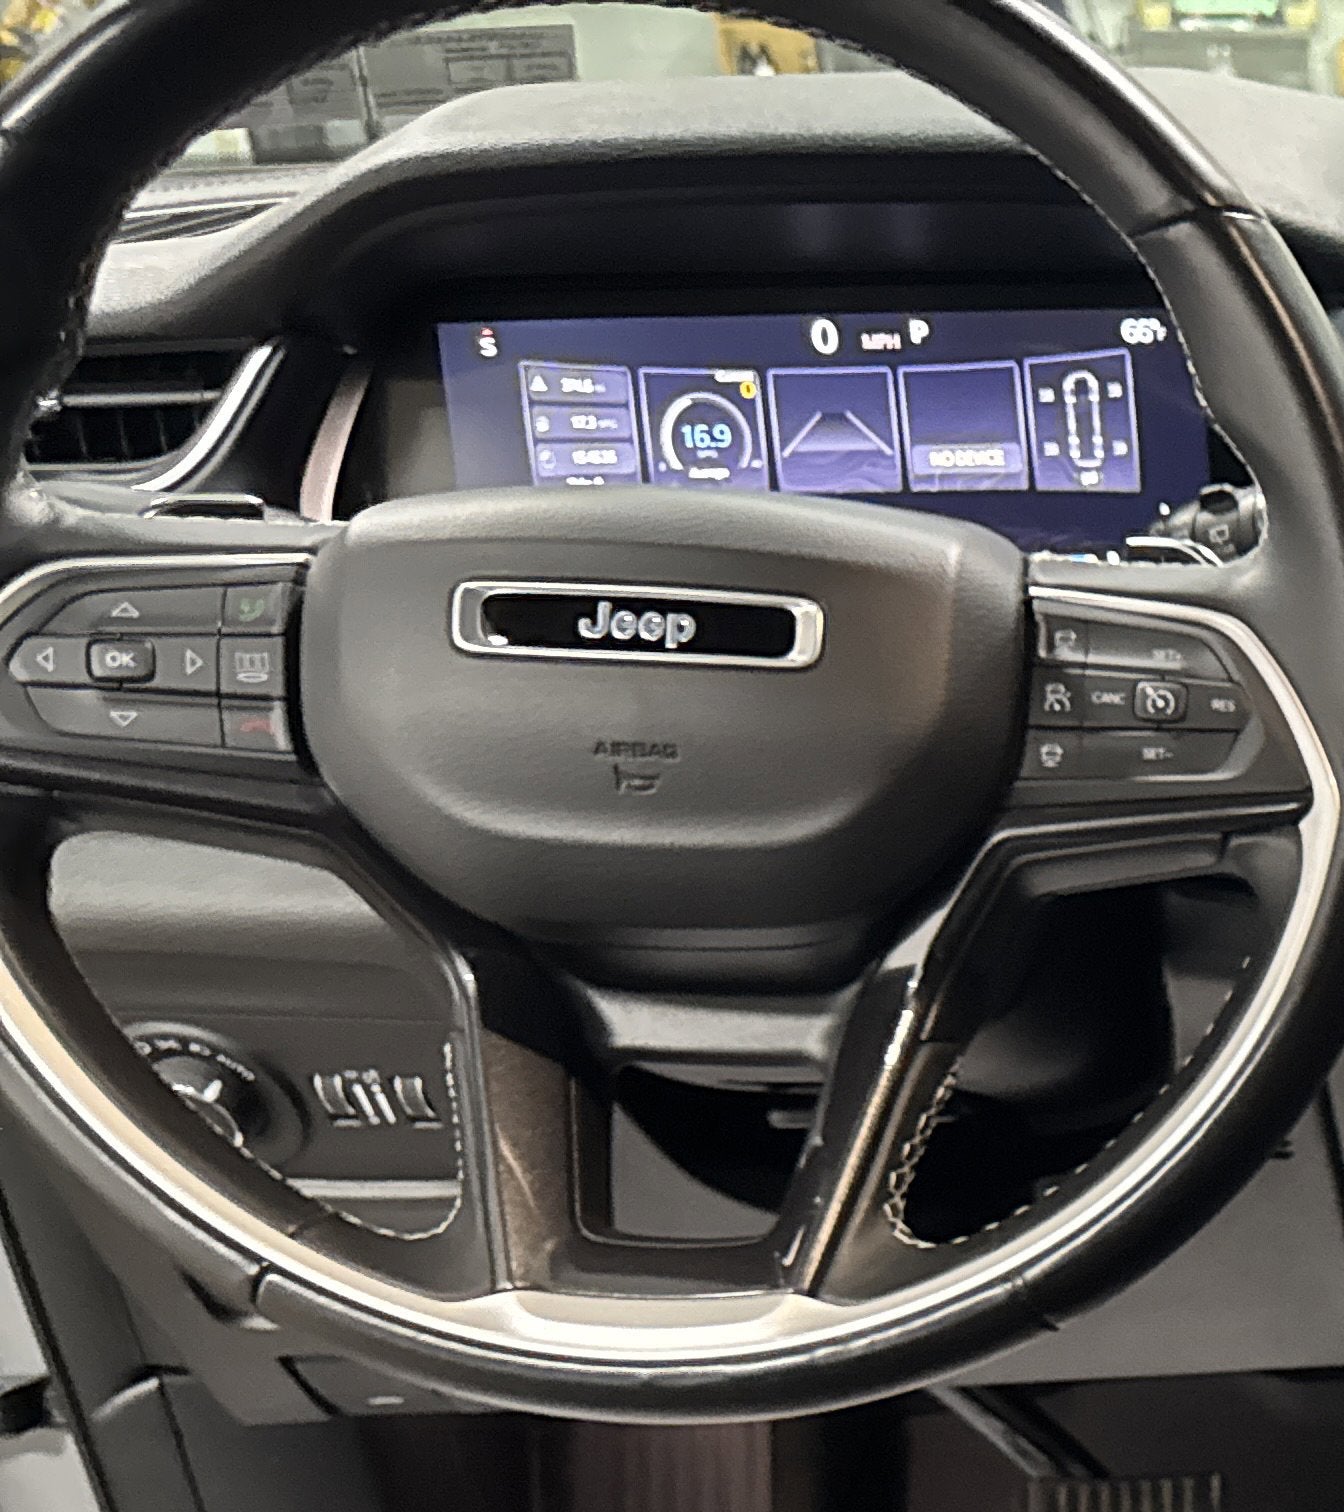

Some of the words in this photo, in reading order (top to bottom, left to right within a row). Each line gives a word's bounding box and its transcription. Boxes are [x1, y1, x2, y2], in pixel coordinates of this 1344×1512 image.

[811, 318, 839, 355] 0
[861, 331, 902, 350] MPH
[909, 319, 929, 344] P
[681, 423, 732, 449] 16.9
[578, 601, 697, 649] Jeep
[105, 650, 137, 668] OK
